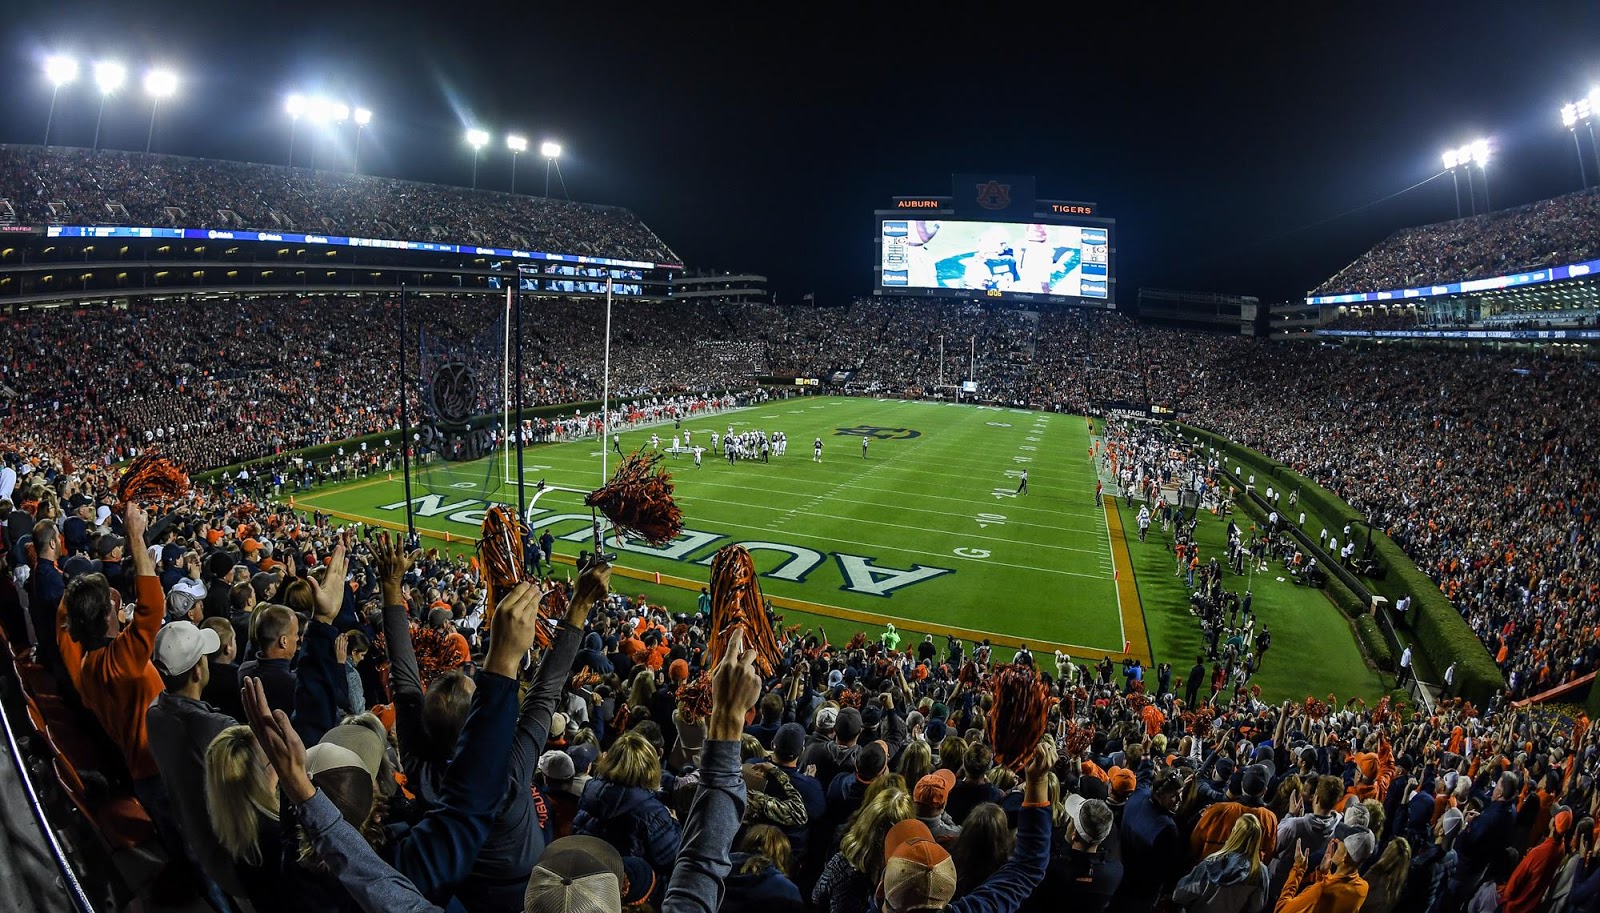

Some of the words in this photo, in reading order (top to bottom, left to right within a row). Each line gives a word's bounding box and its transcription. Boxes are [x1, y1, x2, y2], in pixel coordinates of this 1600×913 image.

[898, 199, 938, 208] AUBURN
[1052, 204, 1092, 214] TIGERS
[952, 547, 992, 559] G
